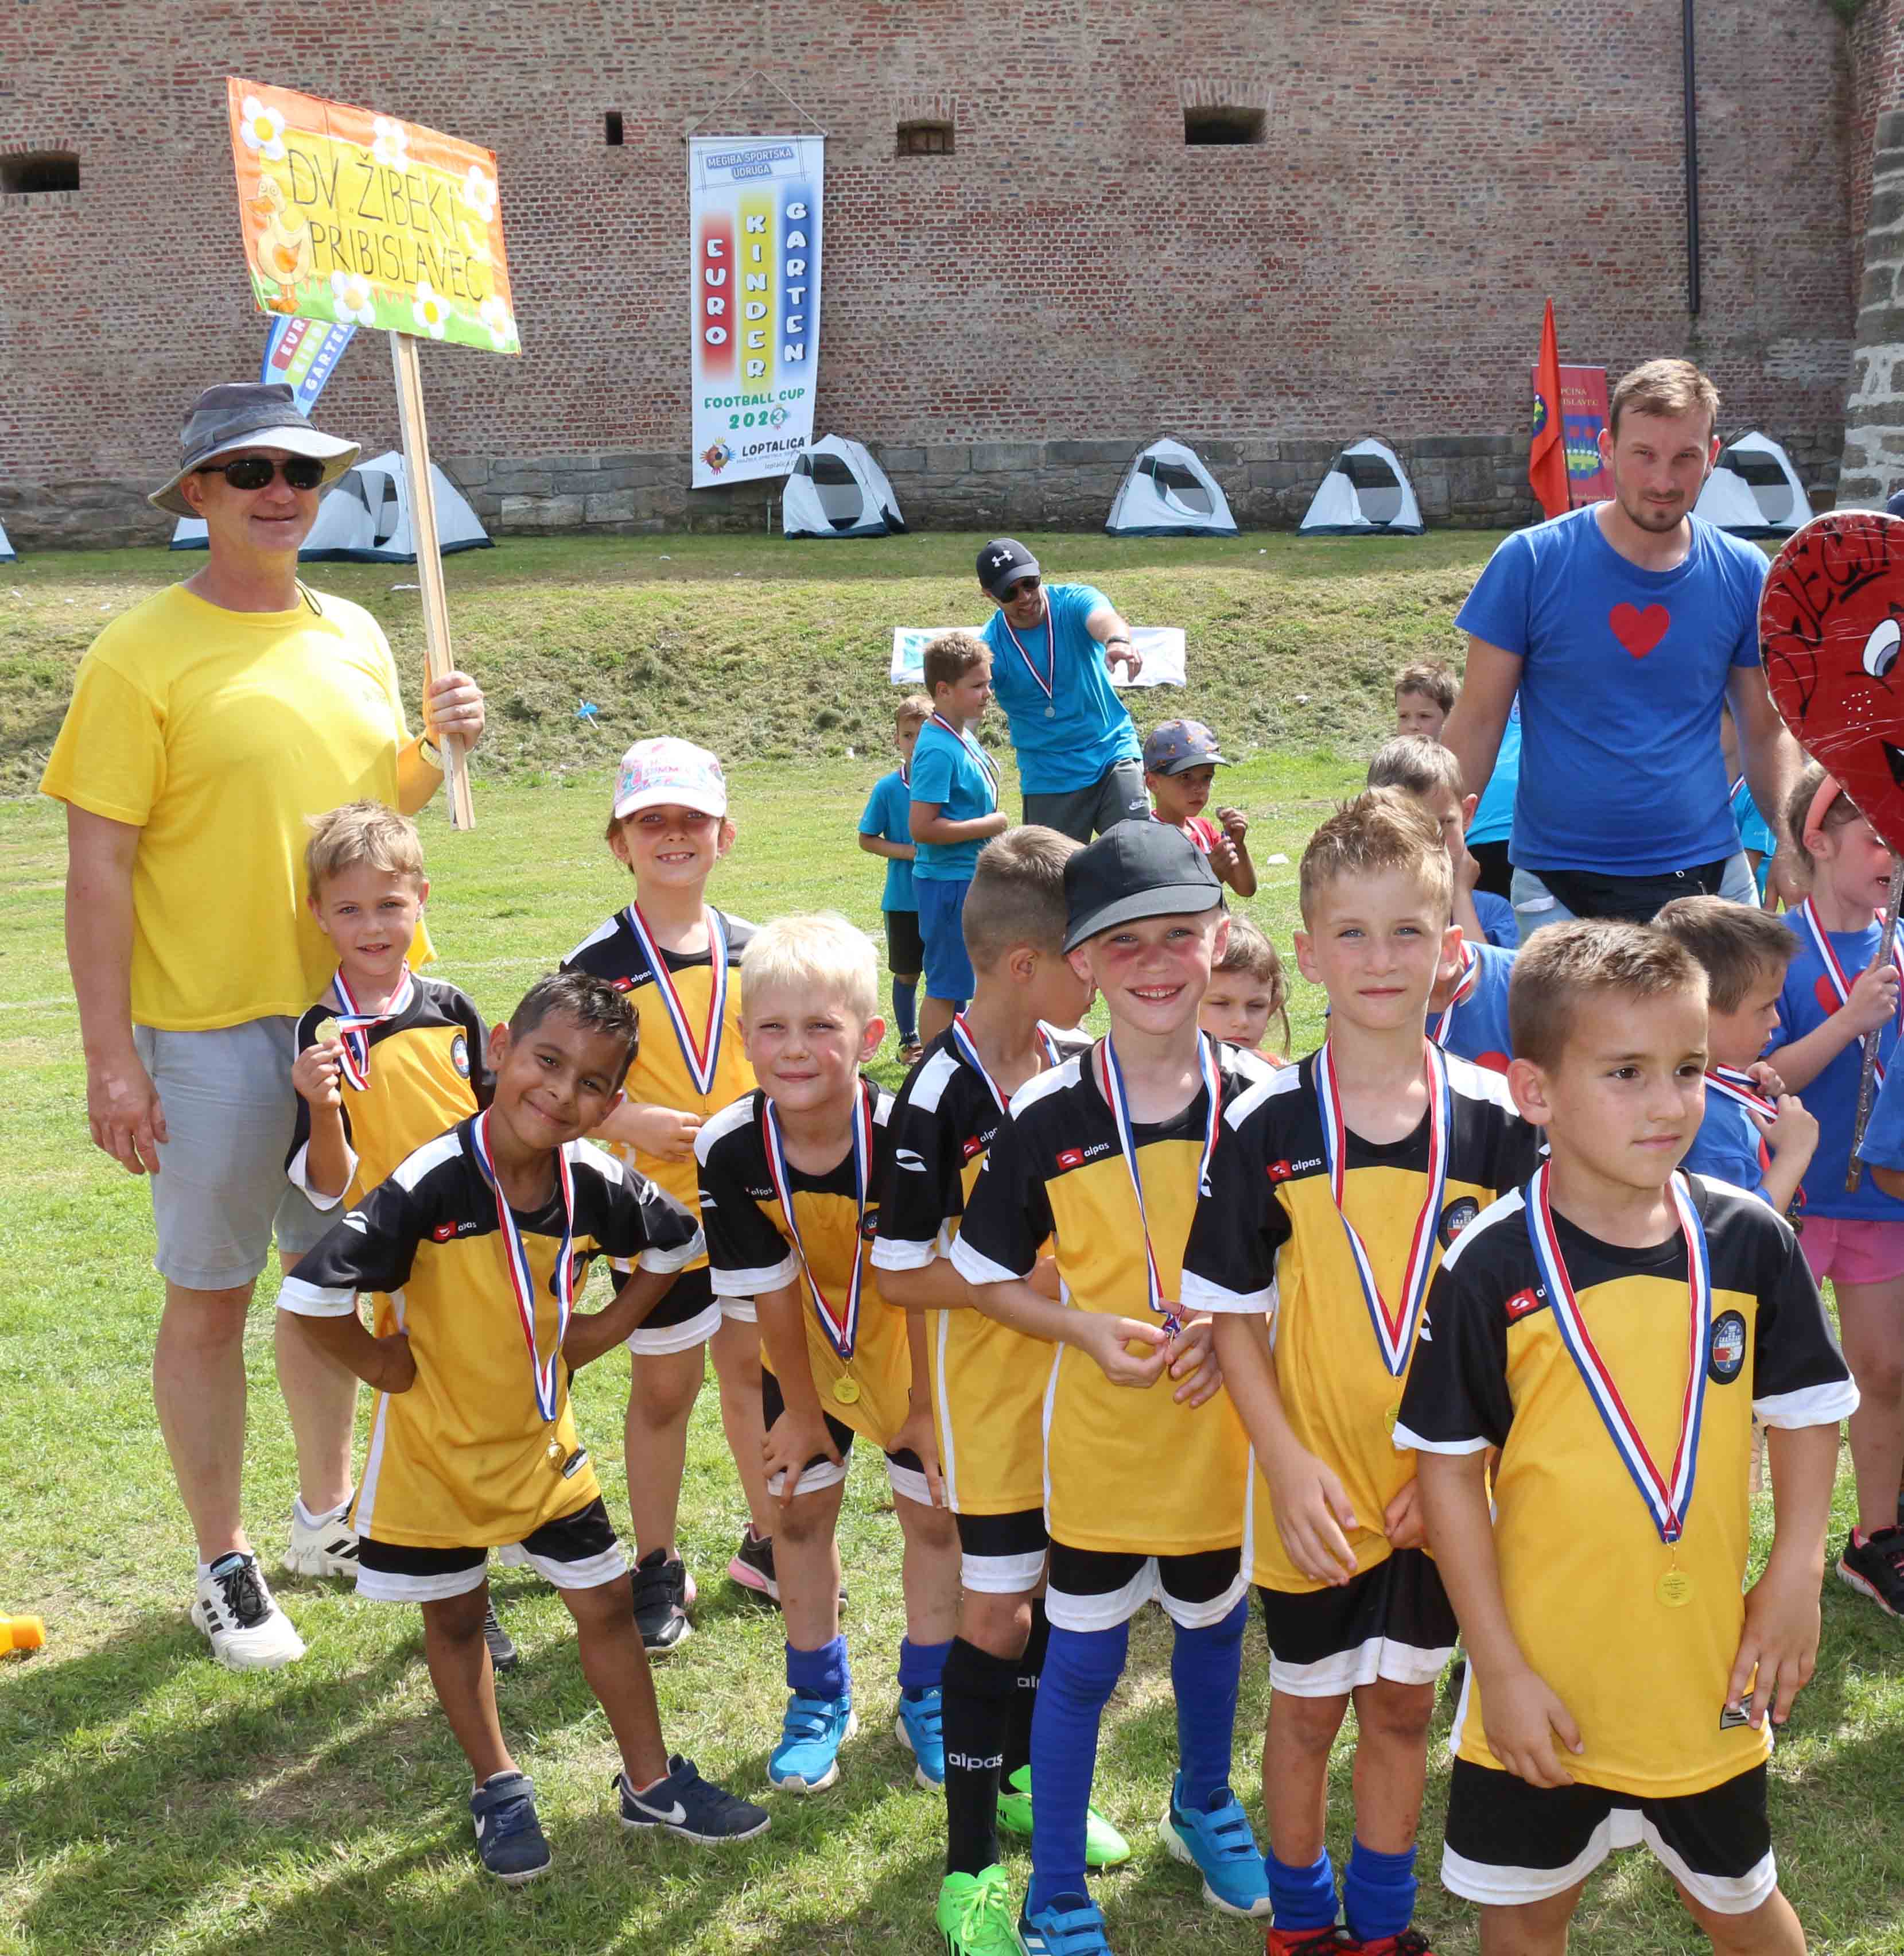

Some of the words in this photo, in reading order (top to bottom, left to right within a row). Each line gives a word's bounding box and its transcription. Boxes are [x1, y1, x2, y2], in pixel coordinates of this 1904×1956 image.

[707, 156, 743, 168] MEGIBA
[745, 147, 793, 164] SPORTSKA
[288, 149, 339, 209] DV
[733, 164, 771, 179] UDRUGA
[309, 221, 483, 302] PRIBISLAVEC
[705, 238, 728, 346] EURO
[784, 203, 807, 362] GARTEN
[745, 215, 767, 377] KINDER
[279, 319, 305, 356] EUR
[704, 393, 775, 409] FOOTBALL
[779, 387, 805, 401] CUP
[742, 437, 805, 456] LOPTALICA
[631, 970, 652, 983] alpas
[1083, 1143, 1110, 1157] alpas
[1292, 1158, 1322, 1171] alpas
[948, 1752, 1003, 1772] alpas
